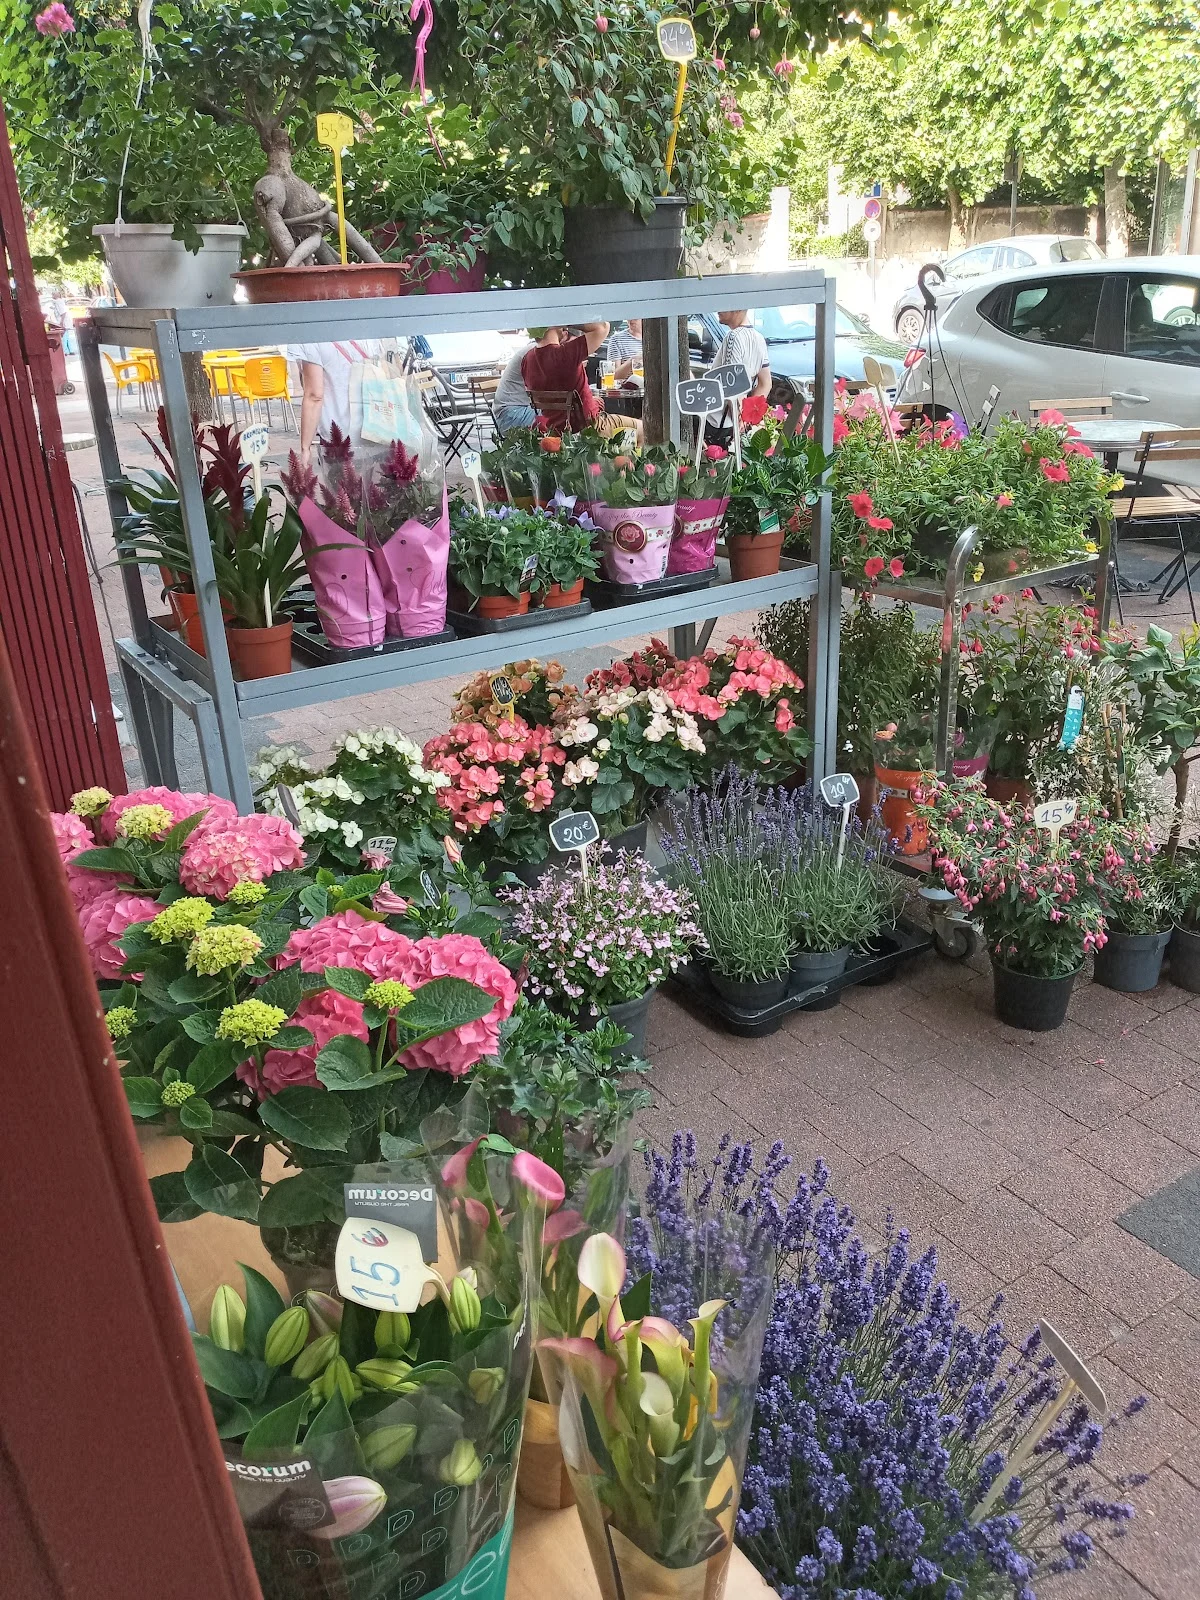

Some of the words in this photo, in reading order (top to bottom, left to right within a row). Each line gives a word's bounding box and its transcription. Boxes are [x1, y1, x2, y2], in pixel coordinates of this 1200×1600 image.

[677, 503, 696, 513] eauty
[632, 509, 658, 520] Beauty
[225, 1460, 311, 1477] ecorum
